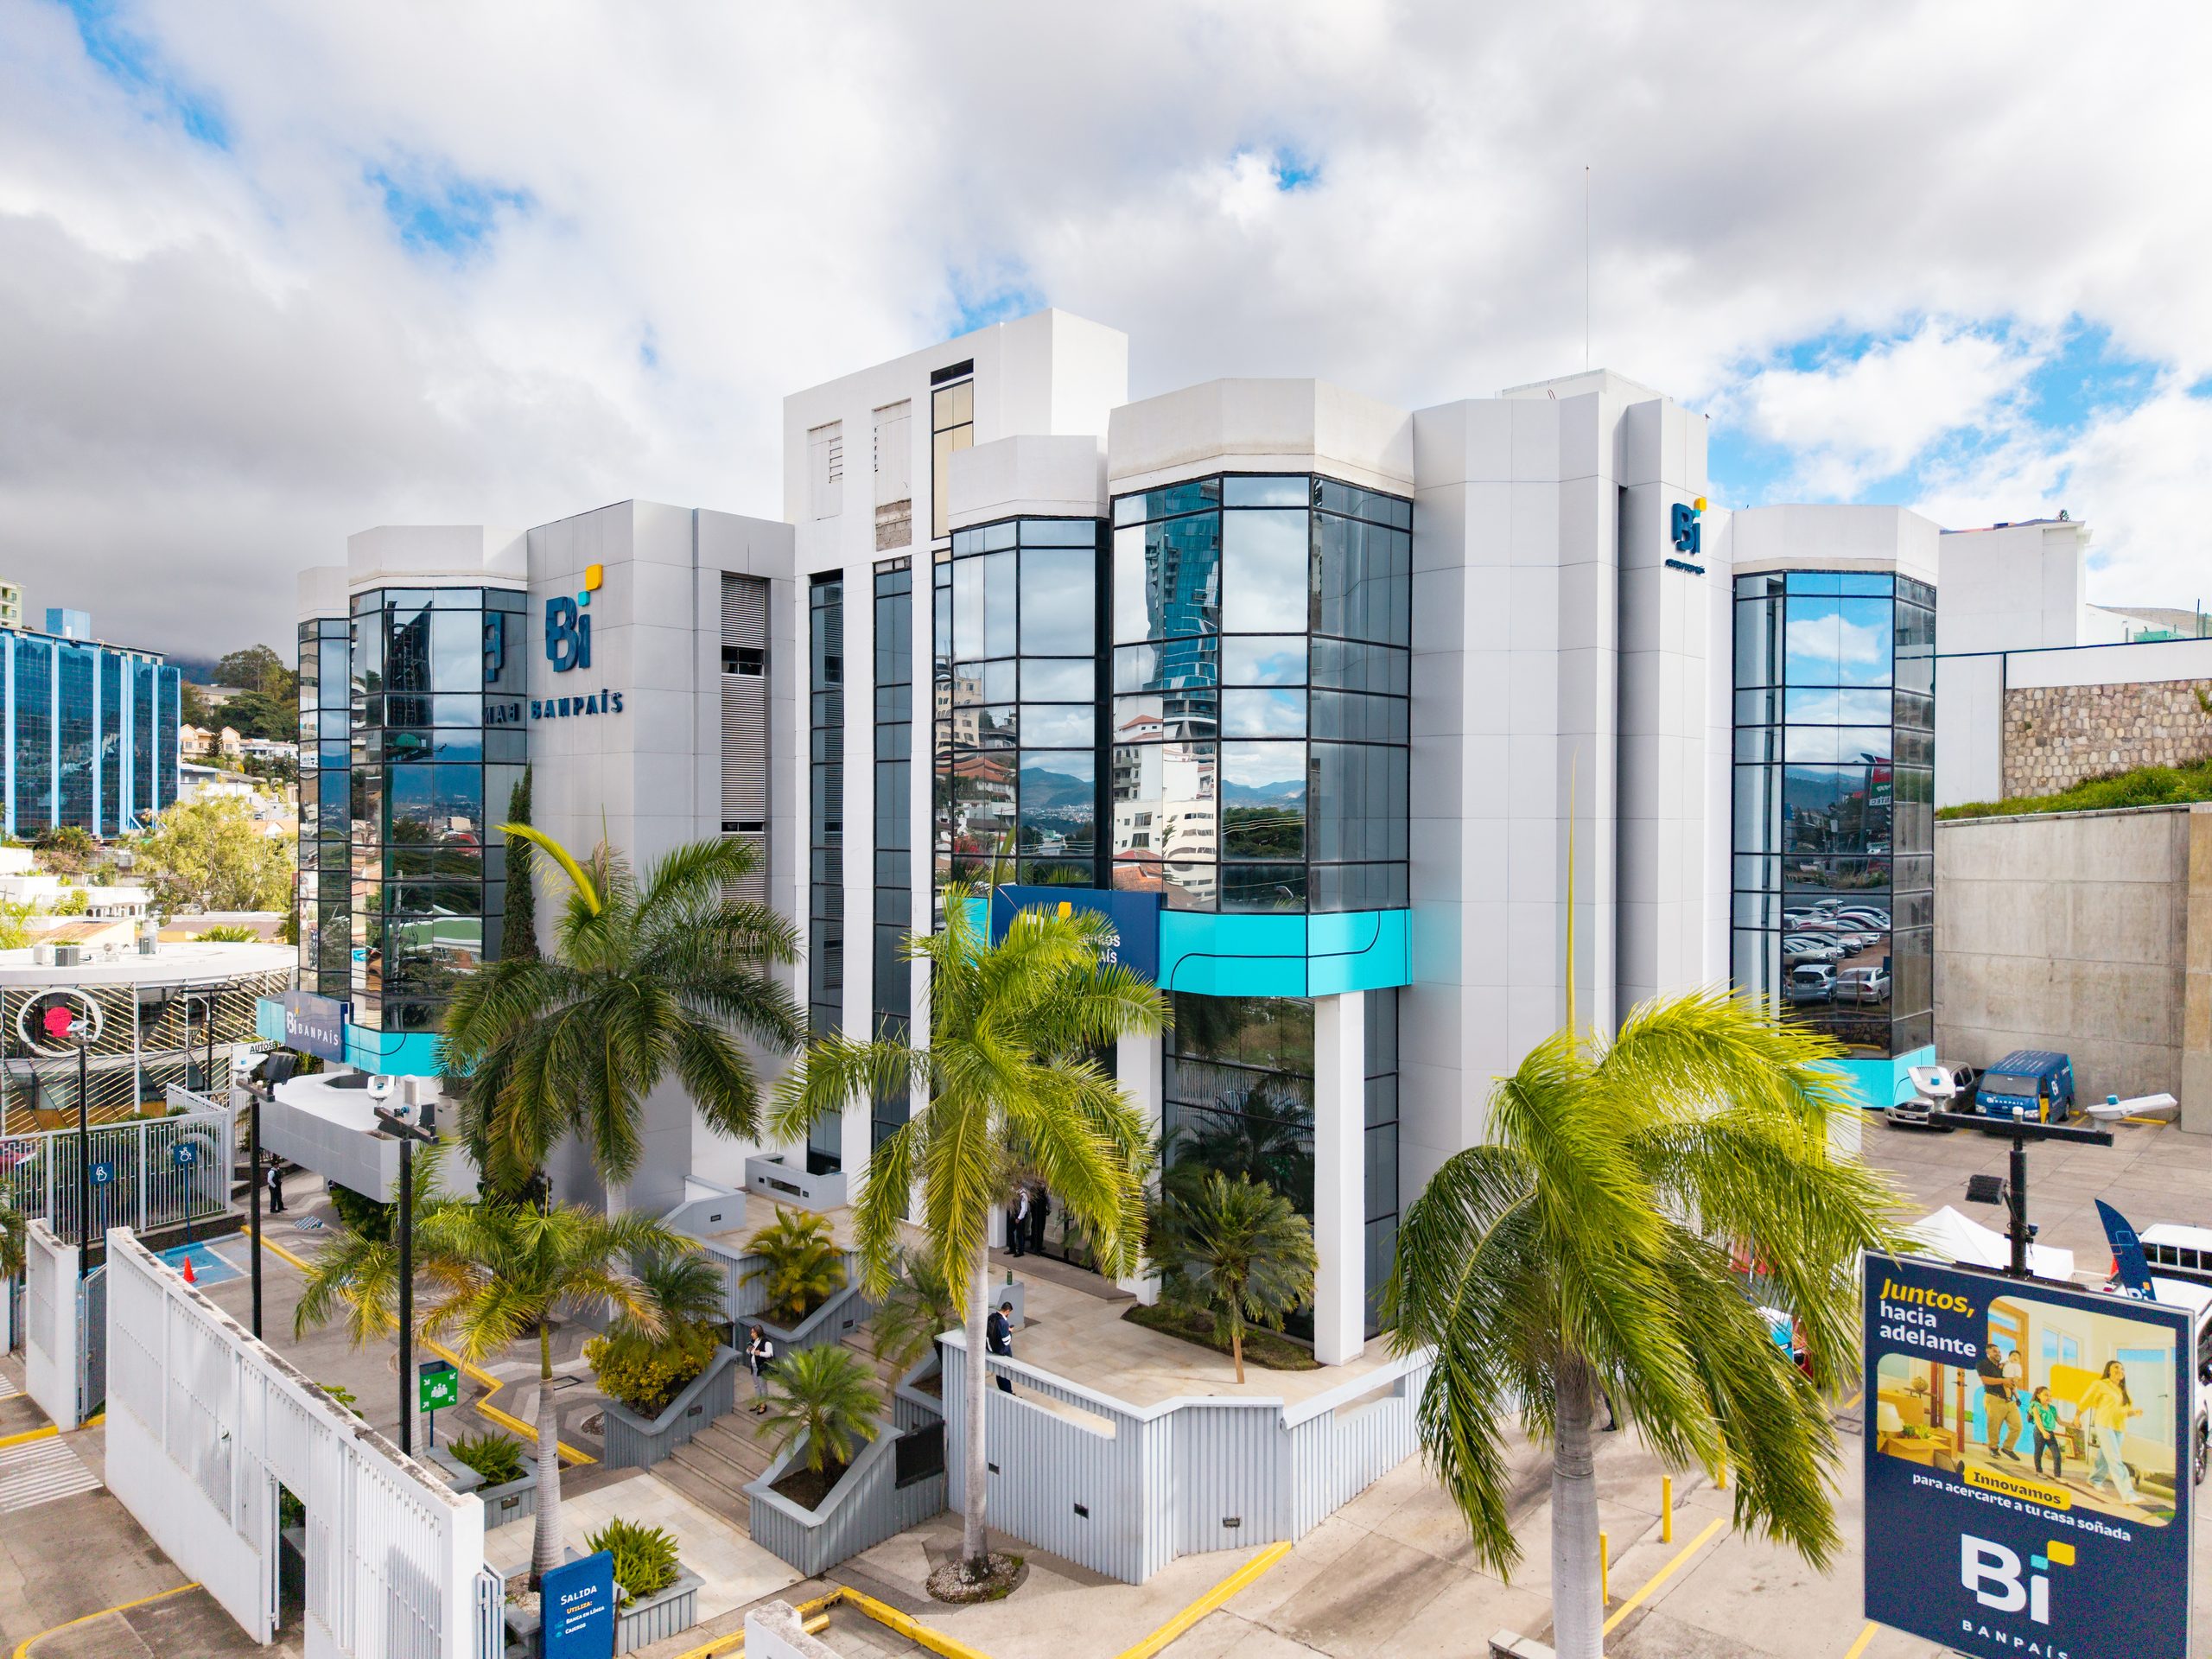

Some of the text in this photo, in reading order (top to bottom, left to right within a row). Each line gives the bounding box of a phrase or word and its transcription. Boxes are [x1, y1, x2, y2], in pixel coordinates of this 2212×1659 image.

[1671, 503, 1700, 554] Bi
[546, 591, 591, 672] Bi
[531, 688, 623, 720] BANPAÍS
[286, 1010, 339, 1046] Bi BANPAÍS
[1879, 1278, 1974, 1319] Juntos,
[1880, 1300, 1937, 1328] hacia
[1879, 1325, 1977, 1357] adelante
[1912, 1472, 2132, 1542] para acercarte a tu casa soñada
[1974, 1471, 2062, 1505] Innovamos
[561, 1586, 597, 1605] SALIDA
[1961, 1533, 2049, 1625] Bi
[1962, 1619, 2068, 1659] BANPAÍS
